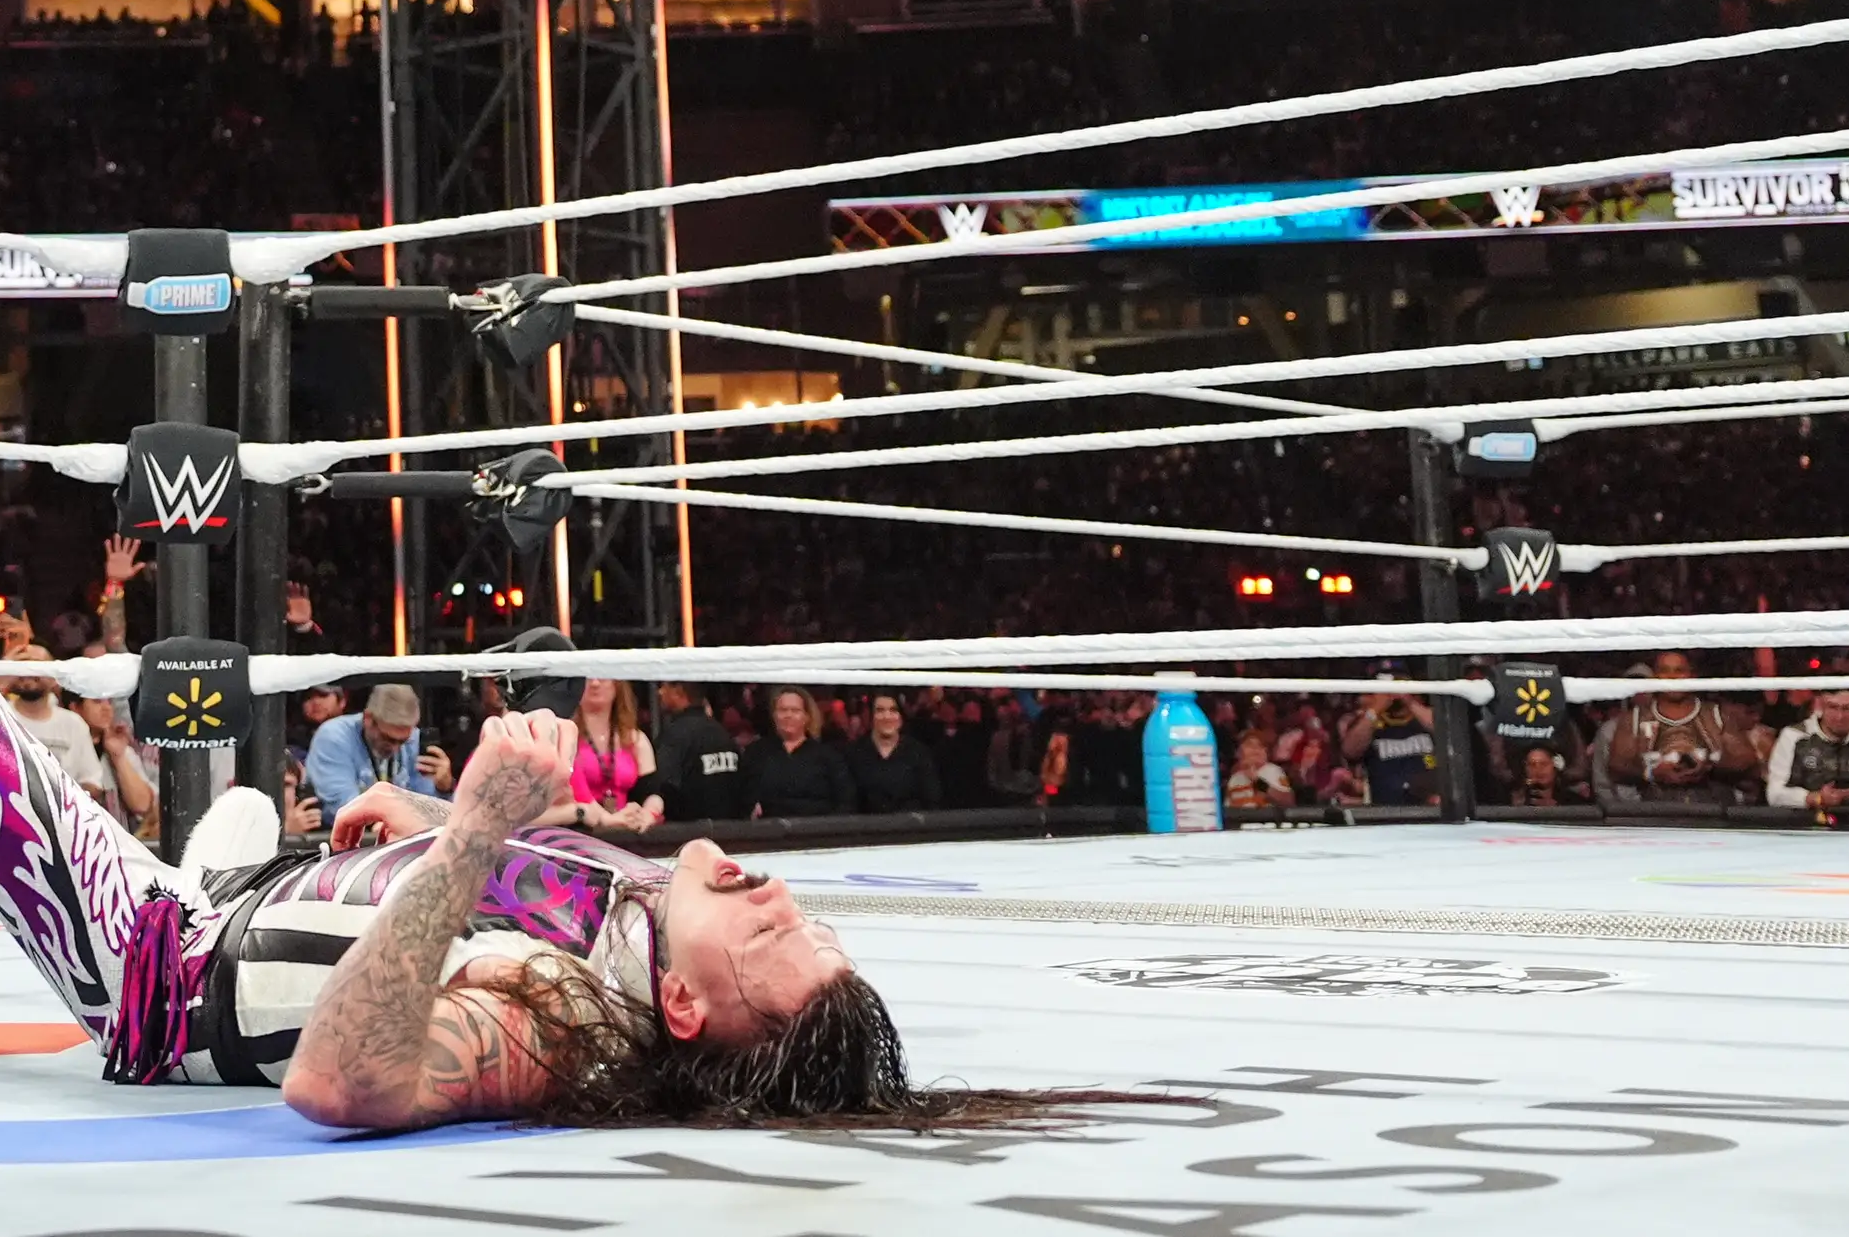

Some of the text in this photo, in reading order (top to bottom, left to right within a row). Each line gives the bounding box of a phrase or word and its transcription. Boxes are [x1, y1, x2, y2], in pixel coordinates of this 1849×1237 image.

[1673, 171, 1834, 214] SURVIVOR
[159, 283, 216, 307] PRIME
[157, 658, 234, 672] AVAILABLE AT
[145, 736, 237, 750] Walmart
